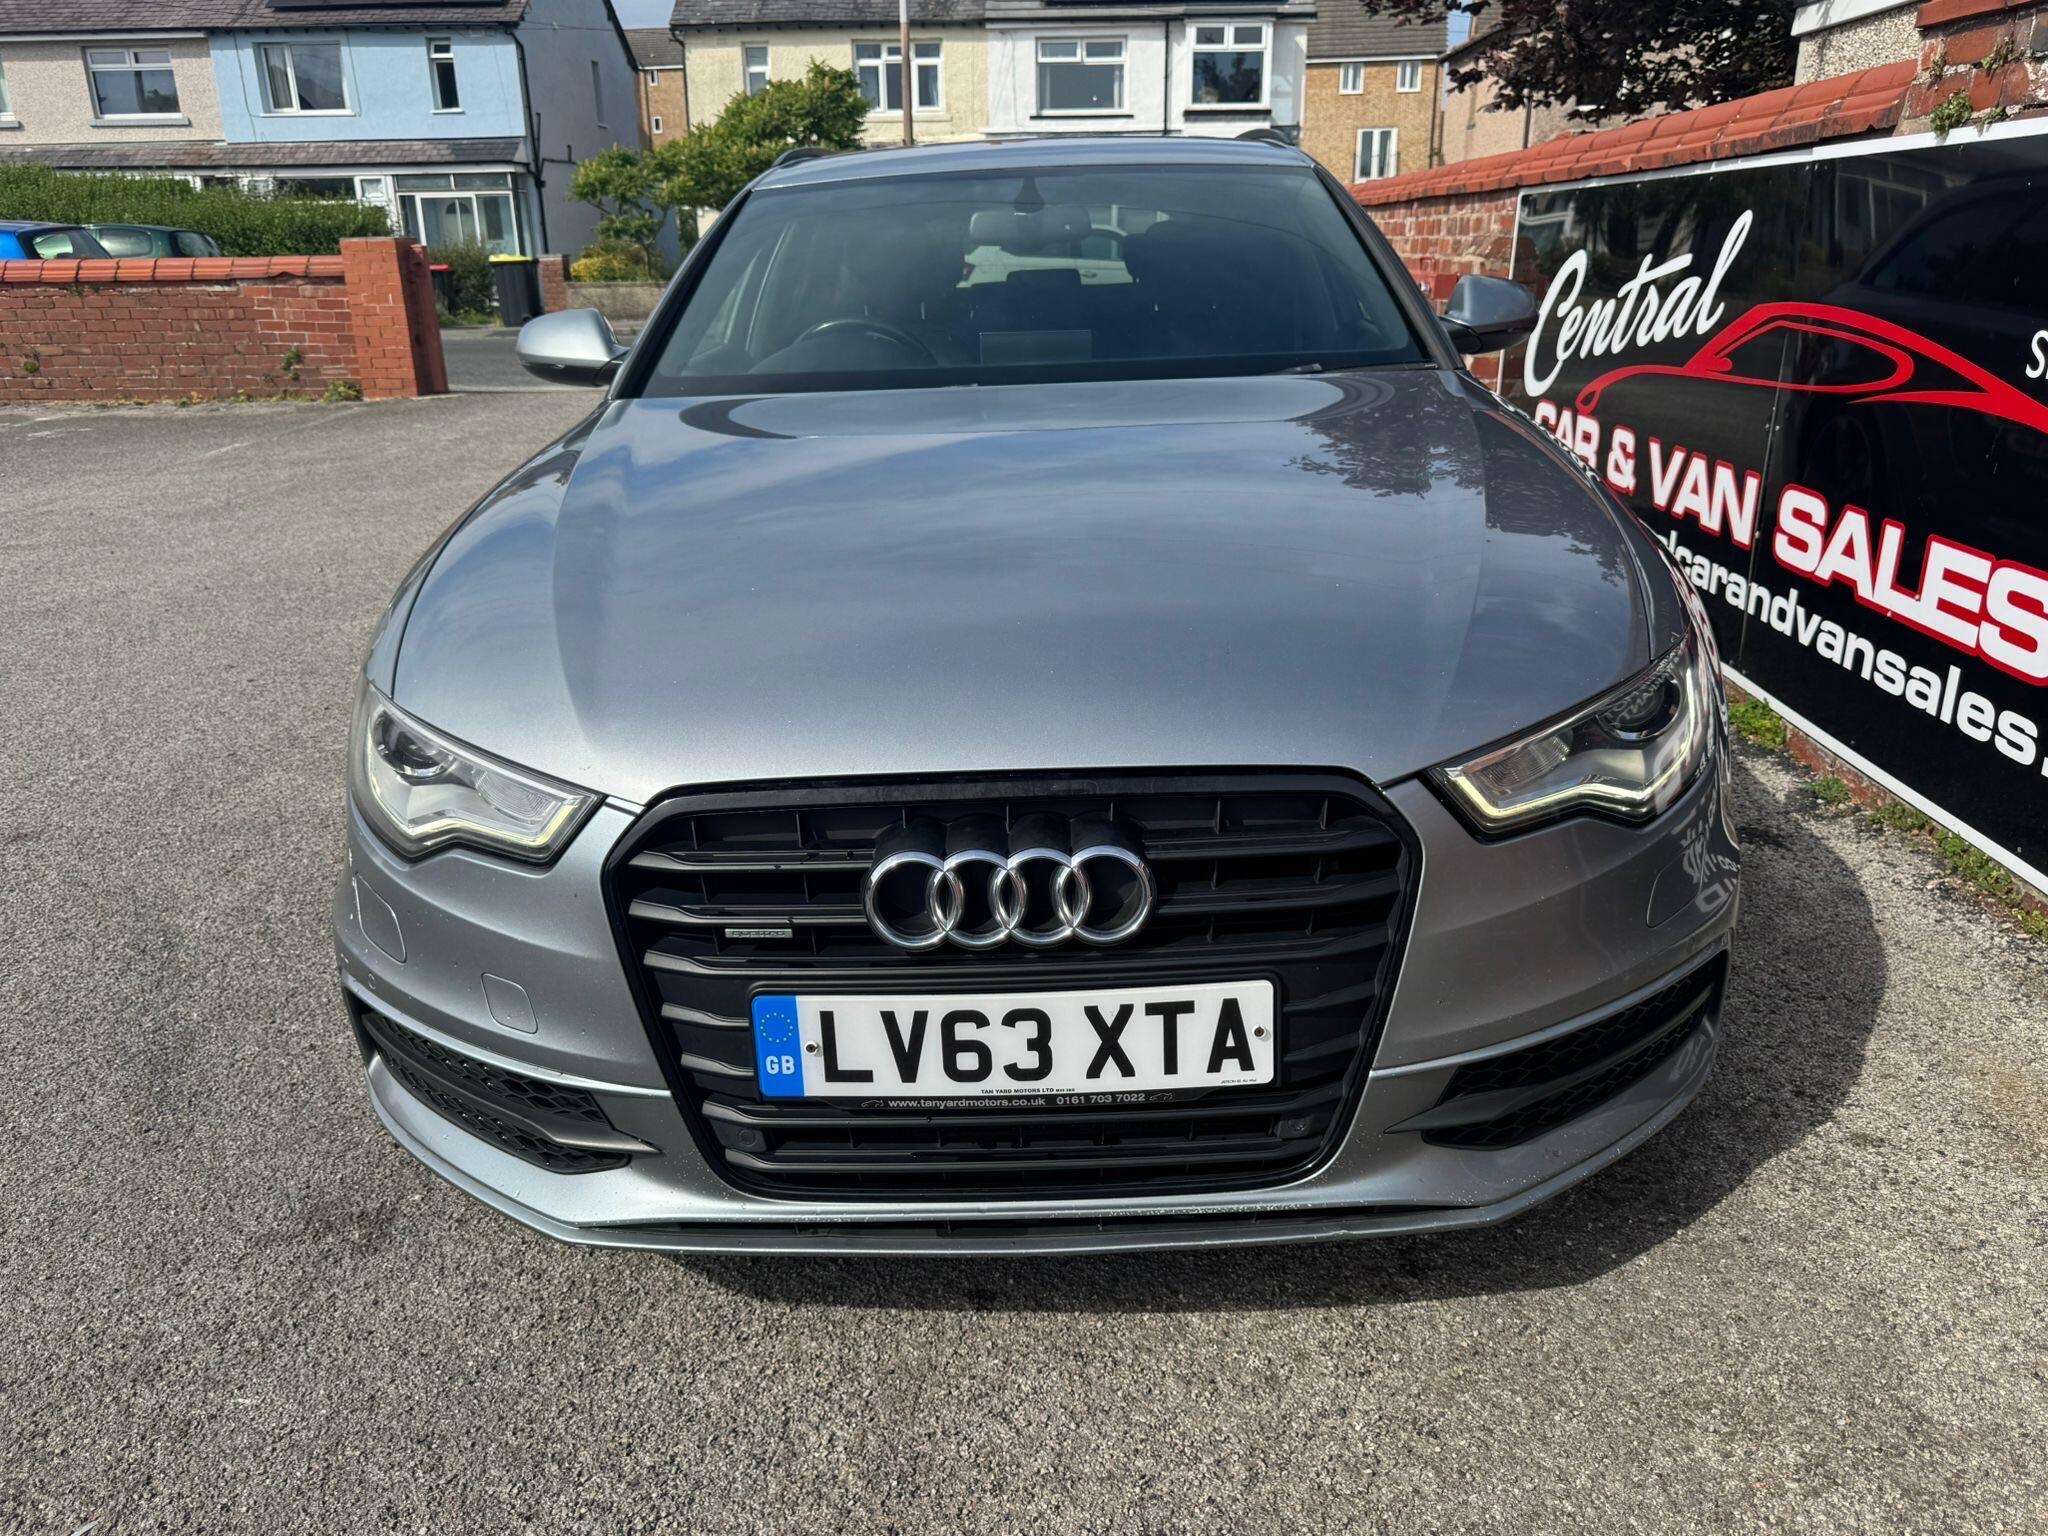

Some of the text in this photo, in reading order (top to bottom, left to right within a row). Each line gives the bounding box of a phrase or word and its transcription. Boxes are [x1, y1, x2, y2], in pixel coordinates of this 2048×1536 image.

[1523, 209, 1753, 397] Central
[1605, 424, 1636, 495] &
[1648, 436, 1761, 549] VAN
[1774, 483, 2048, 684] SALES
[764, 1055, 795, 1075] GB
[818, 997, 1255, 1084] LV63 XTA
[888, 1093, 1146, 1109] www.tanyardmotors.co.uk 0161 703 7022
